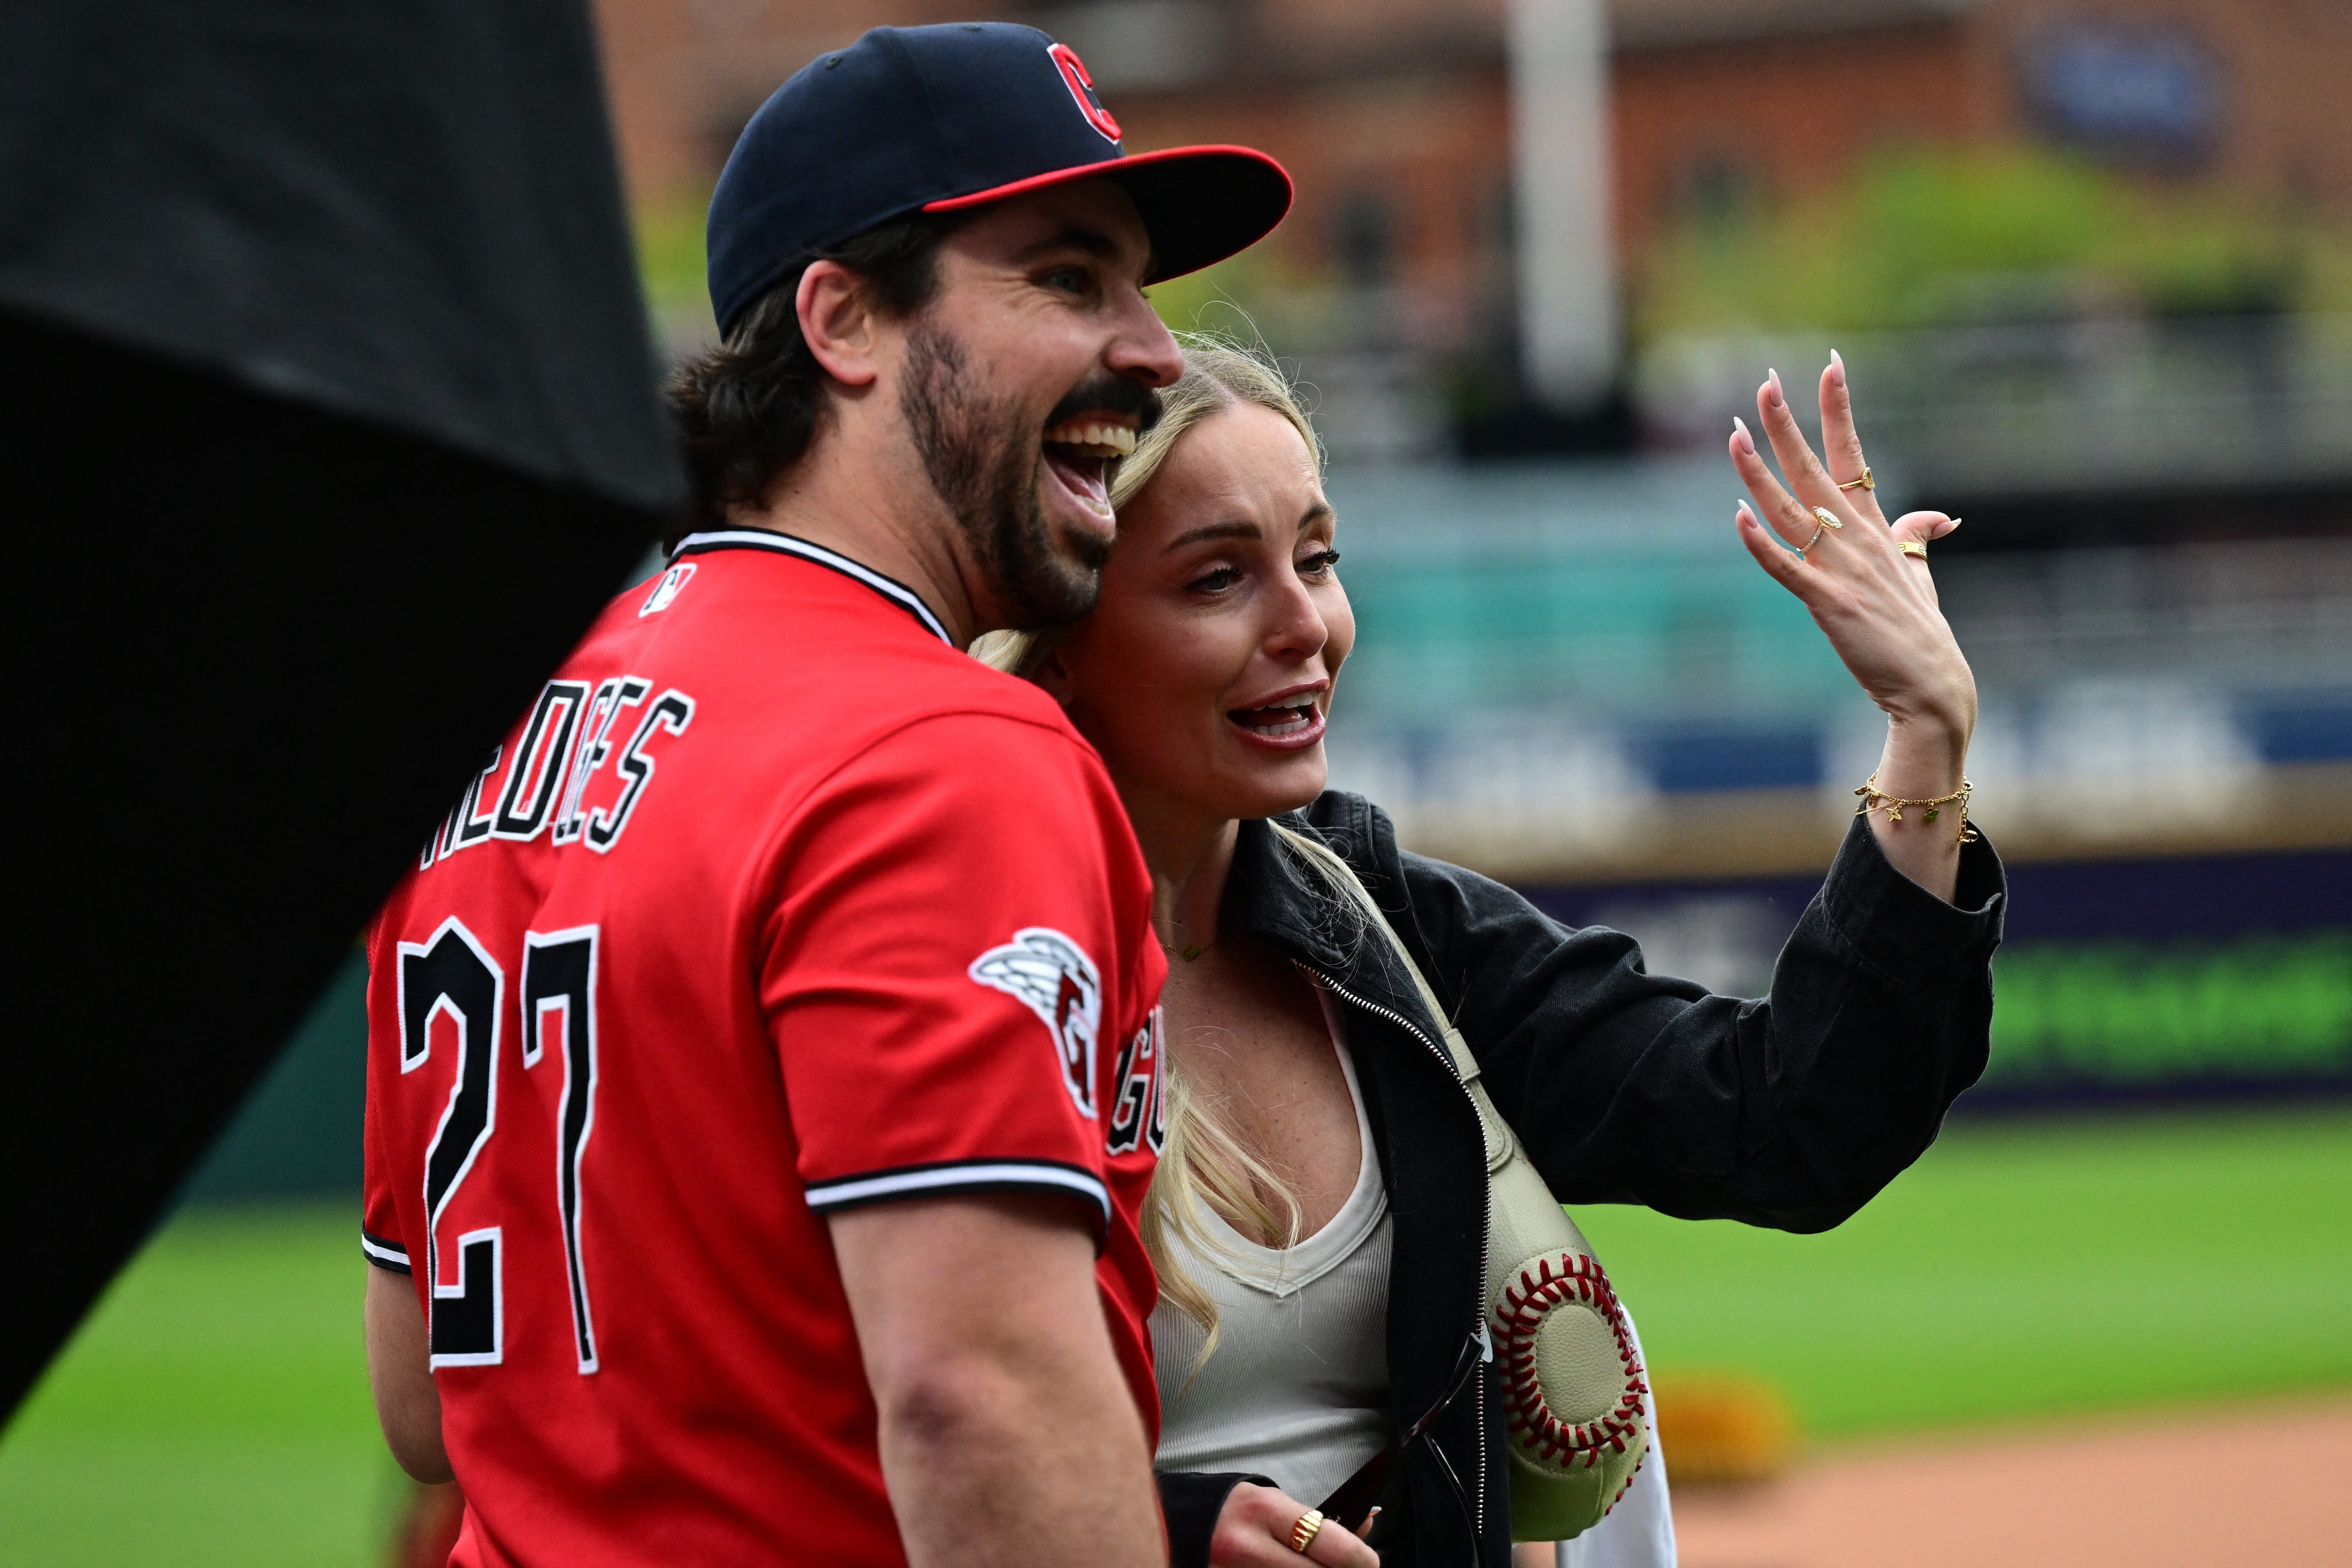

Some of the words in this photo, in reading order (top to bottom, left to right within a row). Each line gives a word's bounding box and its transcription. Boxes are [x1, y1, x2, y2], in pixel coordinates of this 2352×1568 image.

[1047, 43, 1122, 145] C
[419, 675, 695, 872] EDES
[397, 915, 601, 1375] 27
